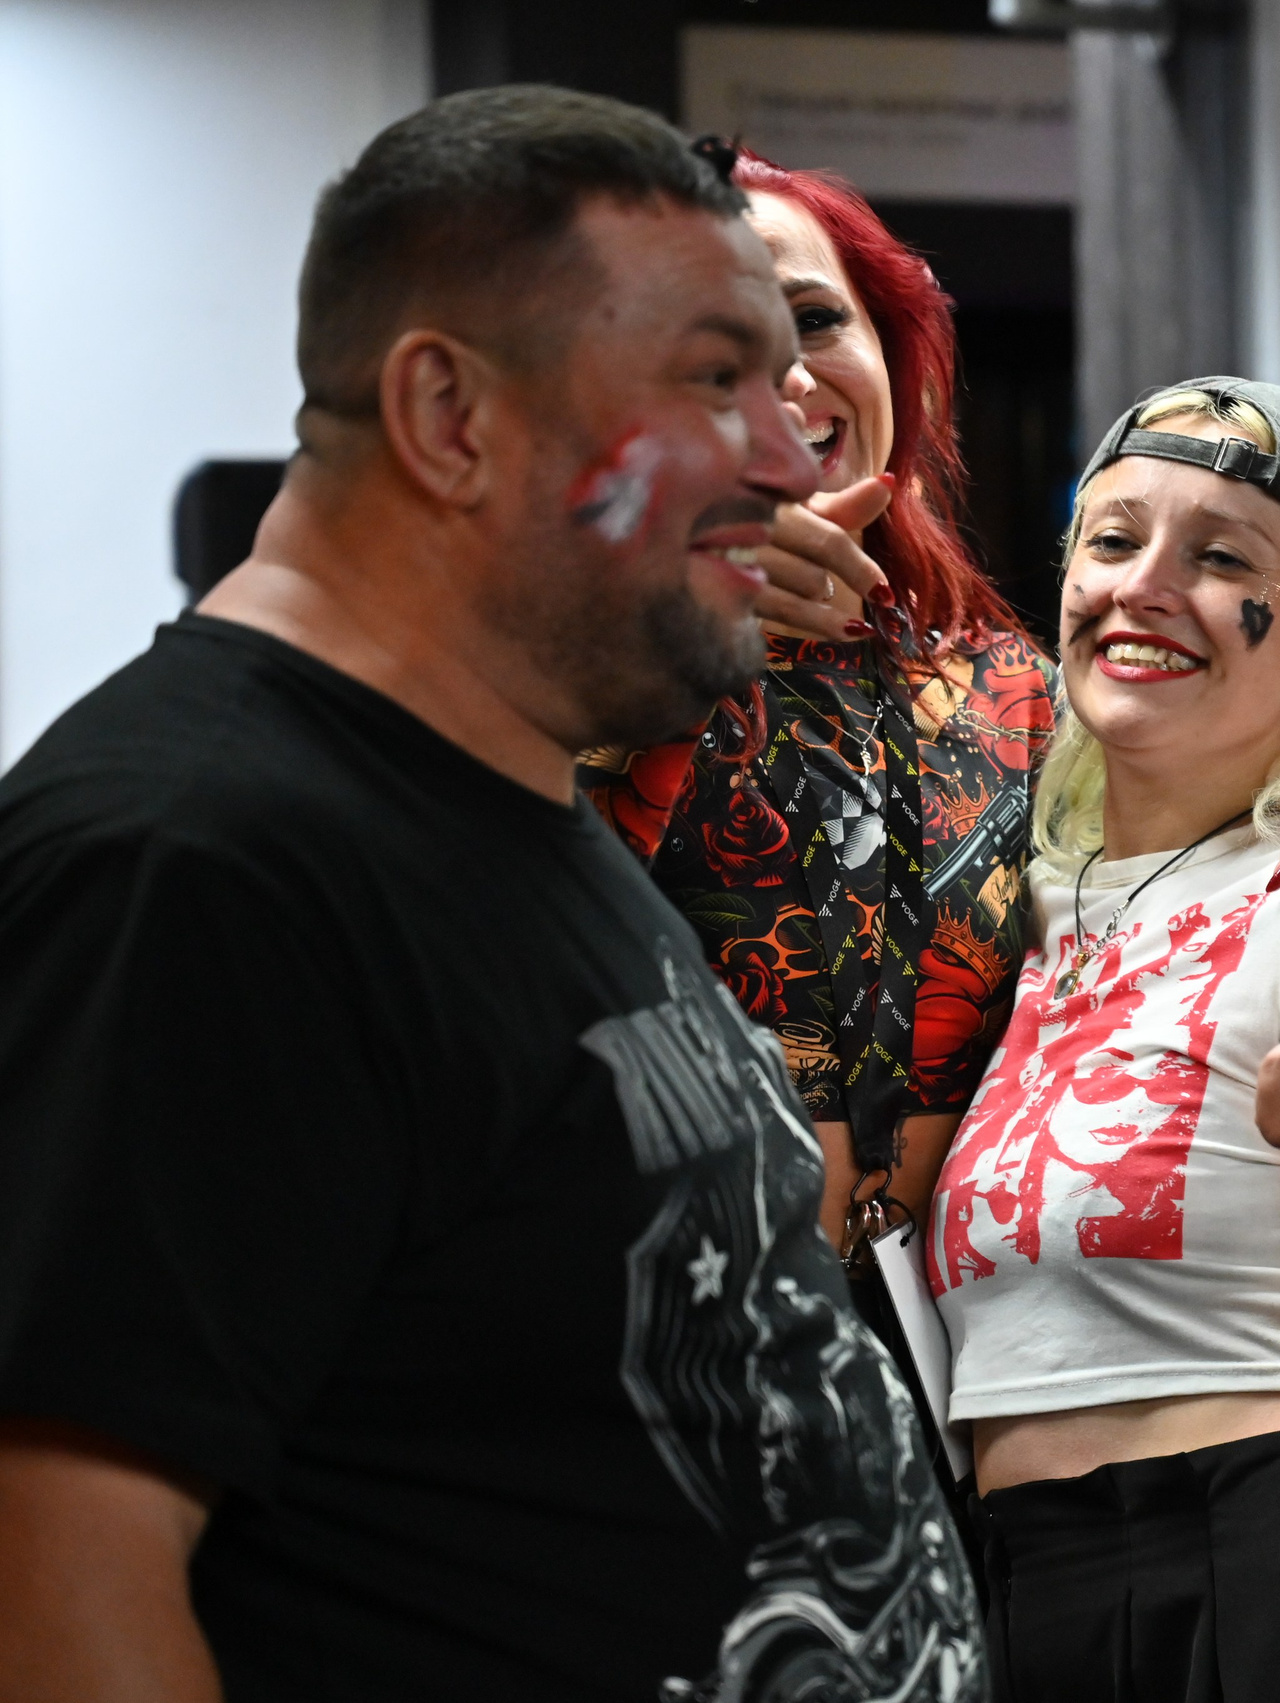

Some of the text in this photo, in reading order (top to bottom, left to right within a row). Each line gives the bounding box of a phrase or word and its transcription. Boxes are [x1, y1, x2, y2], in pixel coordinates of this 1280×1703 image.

[894, 710, 913, 734] VOGE
[766, 745, 779, 767] VOGE
[886, 737, 905, 761] VOGE
[793, 775, 807, 800] VOGE
[901, 801, 921, 827] VOGE
[802, 845, 816, 869] VOGE
[889, 833, 908, 858] VOGE
[827, 878, 842, 904] VOGE
[901, 901, 920, 927] VOGE
[885, 935, 903, 960] VOGE
[830, 950, 846, 976] VOGE
[851, 986, 867, 1012] VOGE
[891, 1006, 912, 1031] VOGE
[872, 1040, 894, 1064] VOGE
[844, 1061, 864, 1087] VOGE
